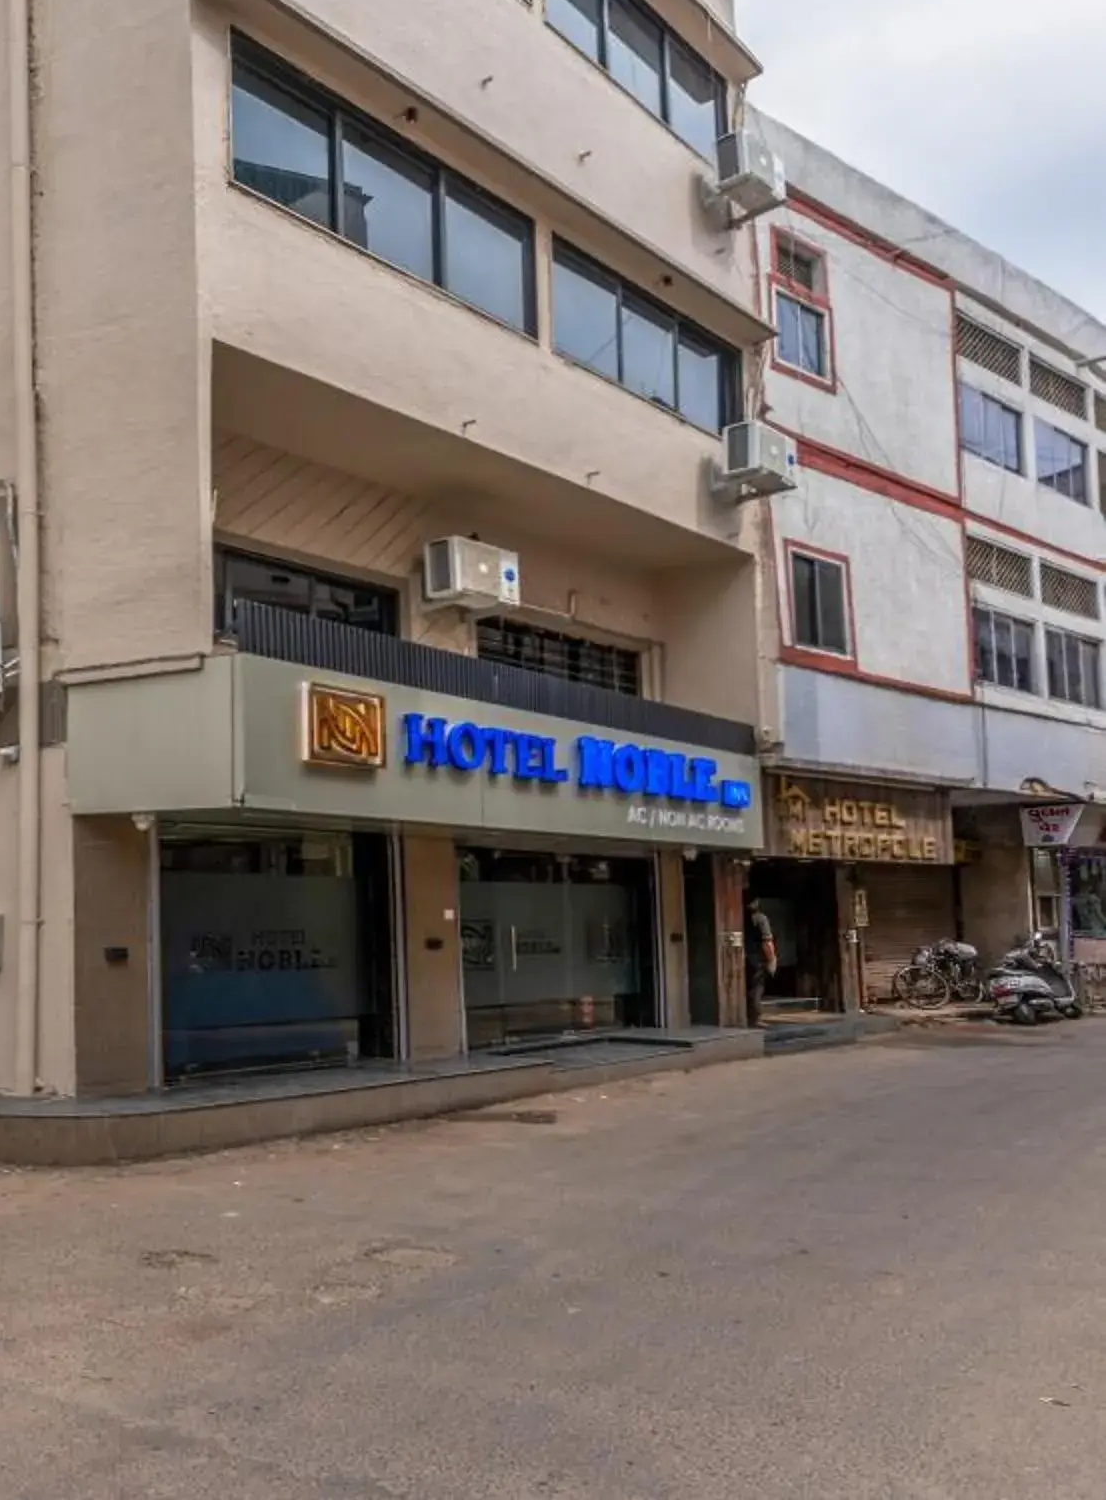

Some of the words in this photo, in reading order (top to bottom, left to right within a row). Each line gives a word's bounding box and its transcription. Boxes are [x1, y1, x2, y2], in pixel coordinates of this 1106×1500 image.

[403, 712, 569, 782] HOTEL
[577, 735, 719, 802] NOBLE
[627, 805, 646, 824] AC
[824, 798, 906, 828] HOTEL
[791, 828, 937, 860] METROPOLE
